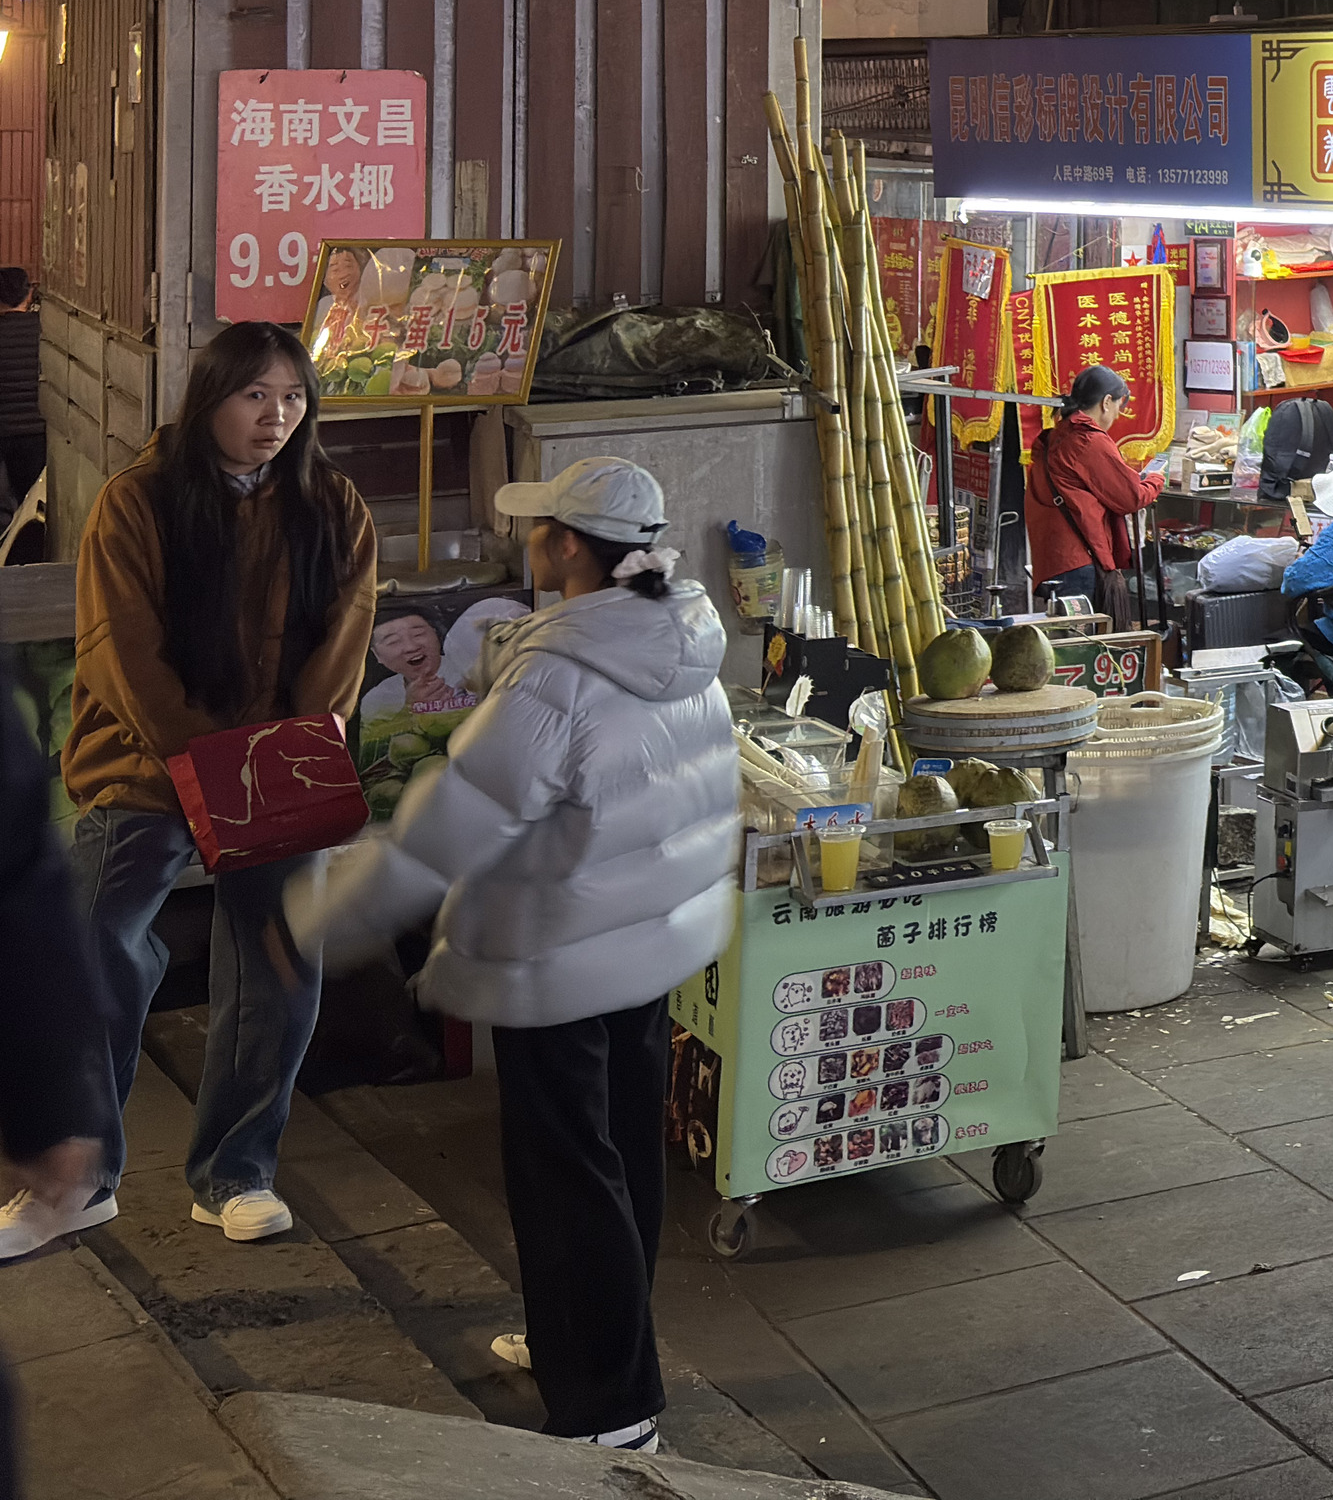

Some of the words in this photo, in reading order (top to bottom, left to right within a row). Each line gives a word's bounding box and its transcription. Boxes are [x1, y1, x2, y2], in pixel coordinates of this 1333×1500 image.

[230, 98, 416, 148] 海南文昌
[254, 162, 394, 213] 香水椰
[1053, 164, 1114, 185] 人民中路69号
[1157, 167, 1229, 186] 13577123998
[229, 231, 320, 290] 9.9
[1093, 652, 1140, 686] 9.9
[876, 910, 998, 949] 菌子排行榜
